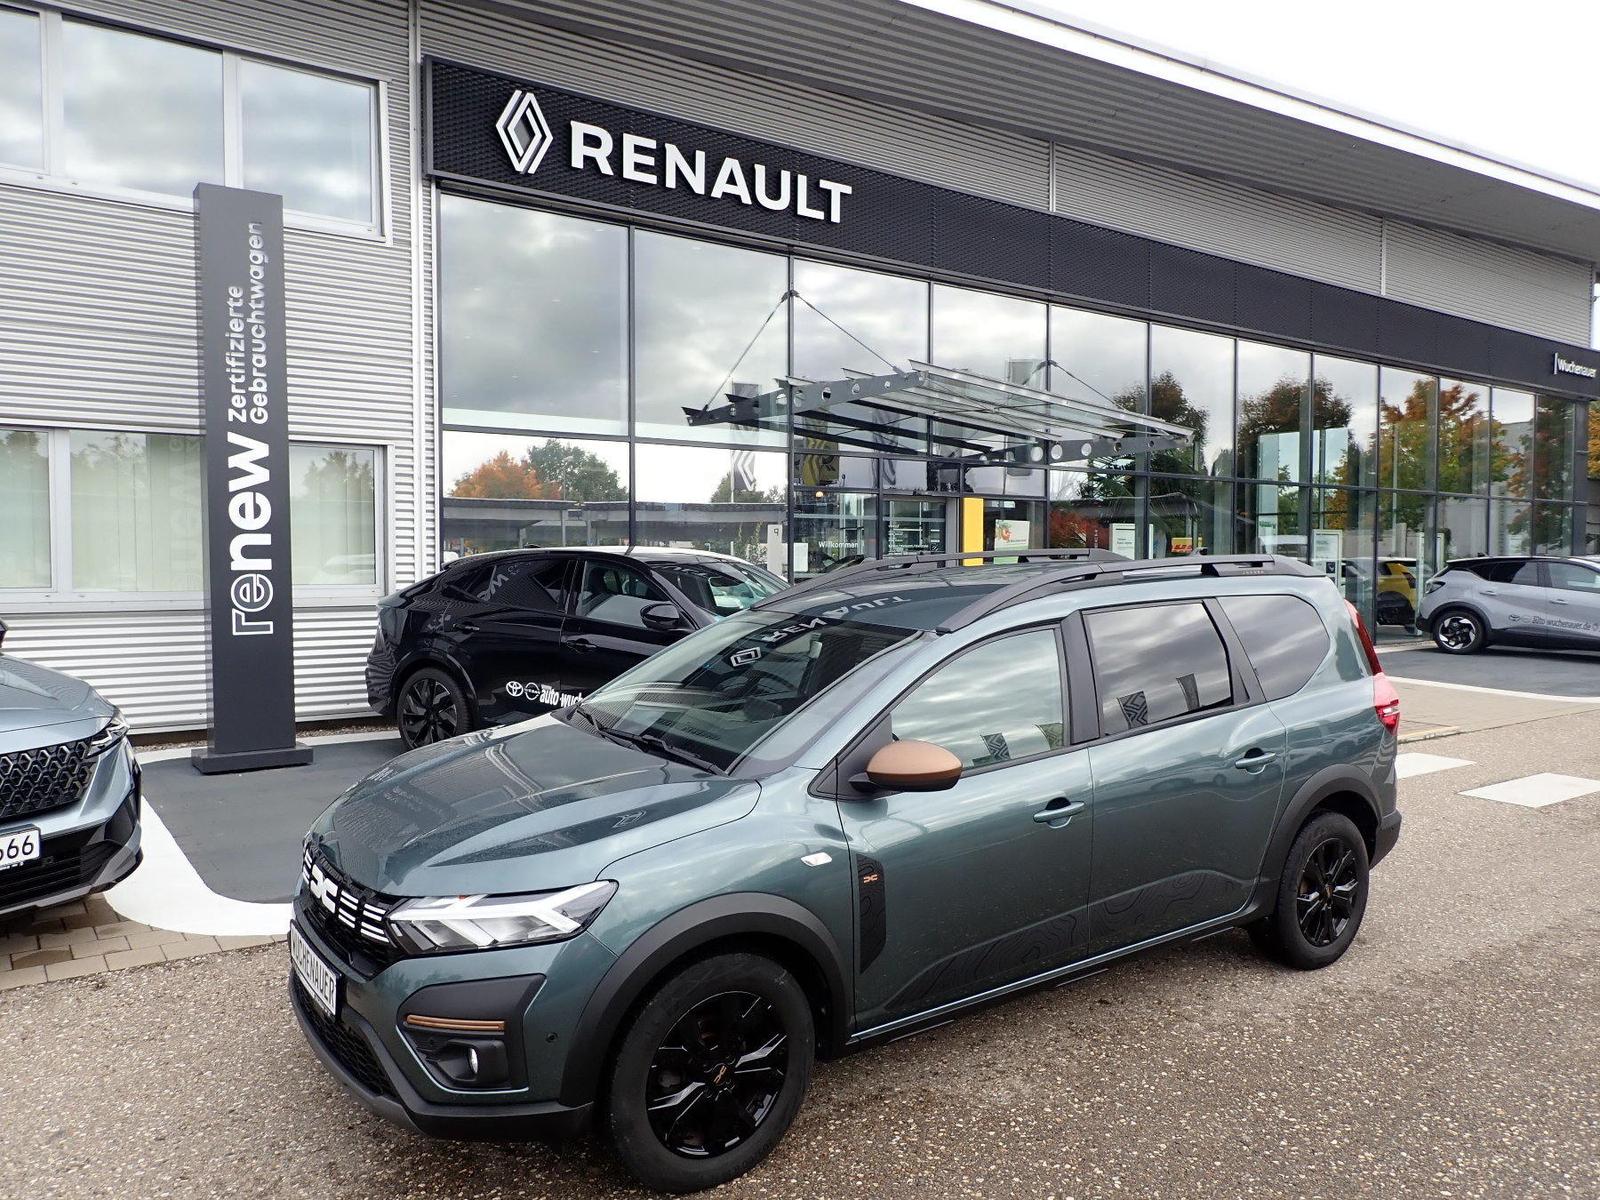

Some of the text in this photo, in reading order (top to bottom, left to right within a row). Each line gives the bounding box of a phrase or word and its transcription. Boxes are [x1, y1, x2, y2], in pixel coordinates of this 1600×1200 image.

[570, 120, 852, 223] RENAULT
[225, 286, 247, 423] Zertifizierte
[247, 221, 269, 424] Gebrauchtwagen
[1557, 357, 1597, 378] Wuchenauer
[227, 431, 274, 635] renew
[818, 540, 859, 549] Willkommen
[540, 688, 559, 706] auto
